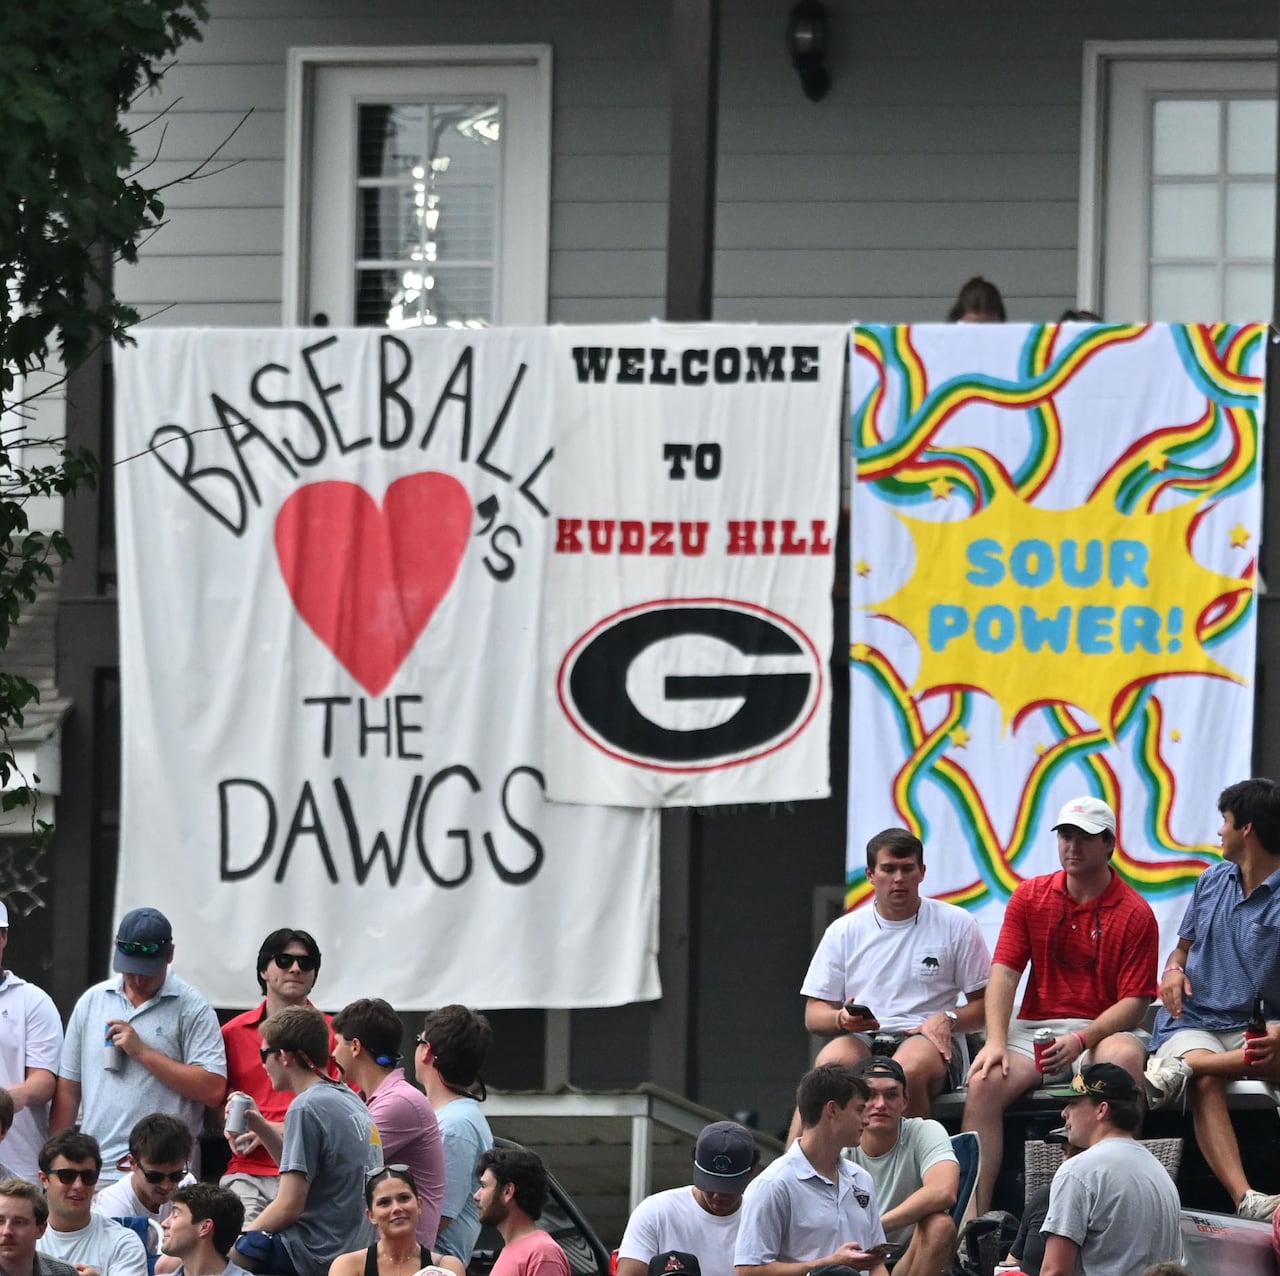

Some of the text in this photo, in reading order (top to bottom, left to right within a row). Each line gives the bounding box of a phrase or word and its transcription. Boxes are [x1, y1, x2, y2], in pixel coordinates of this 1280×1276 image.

[572, 346, 820, 386] WELCOME
[150, 334, 555, 537] BASEBALL
[663, 443, 722, 481] TO
[555, 518, 832, 557] KUDZU HILL
[965, 537, 1150, 589] SOUR
[927, 603, 1184, 655] POWER!
[569, 604, 809, 761] G
[303, 694, 424, 760] THE
[218, 764, 547, 890] DAWGS
